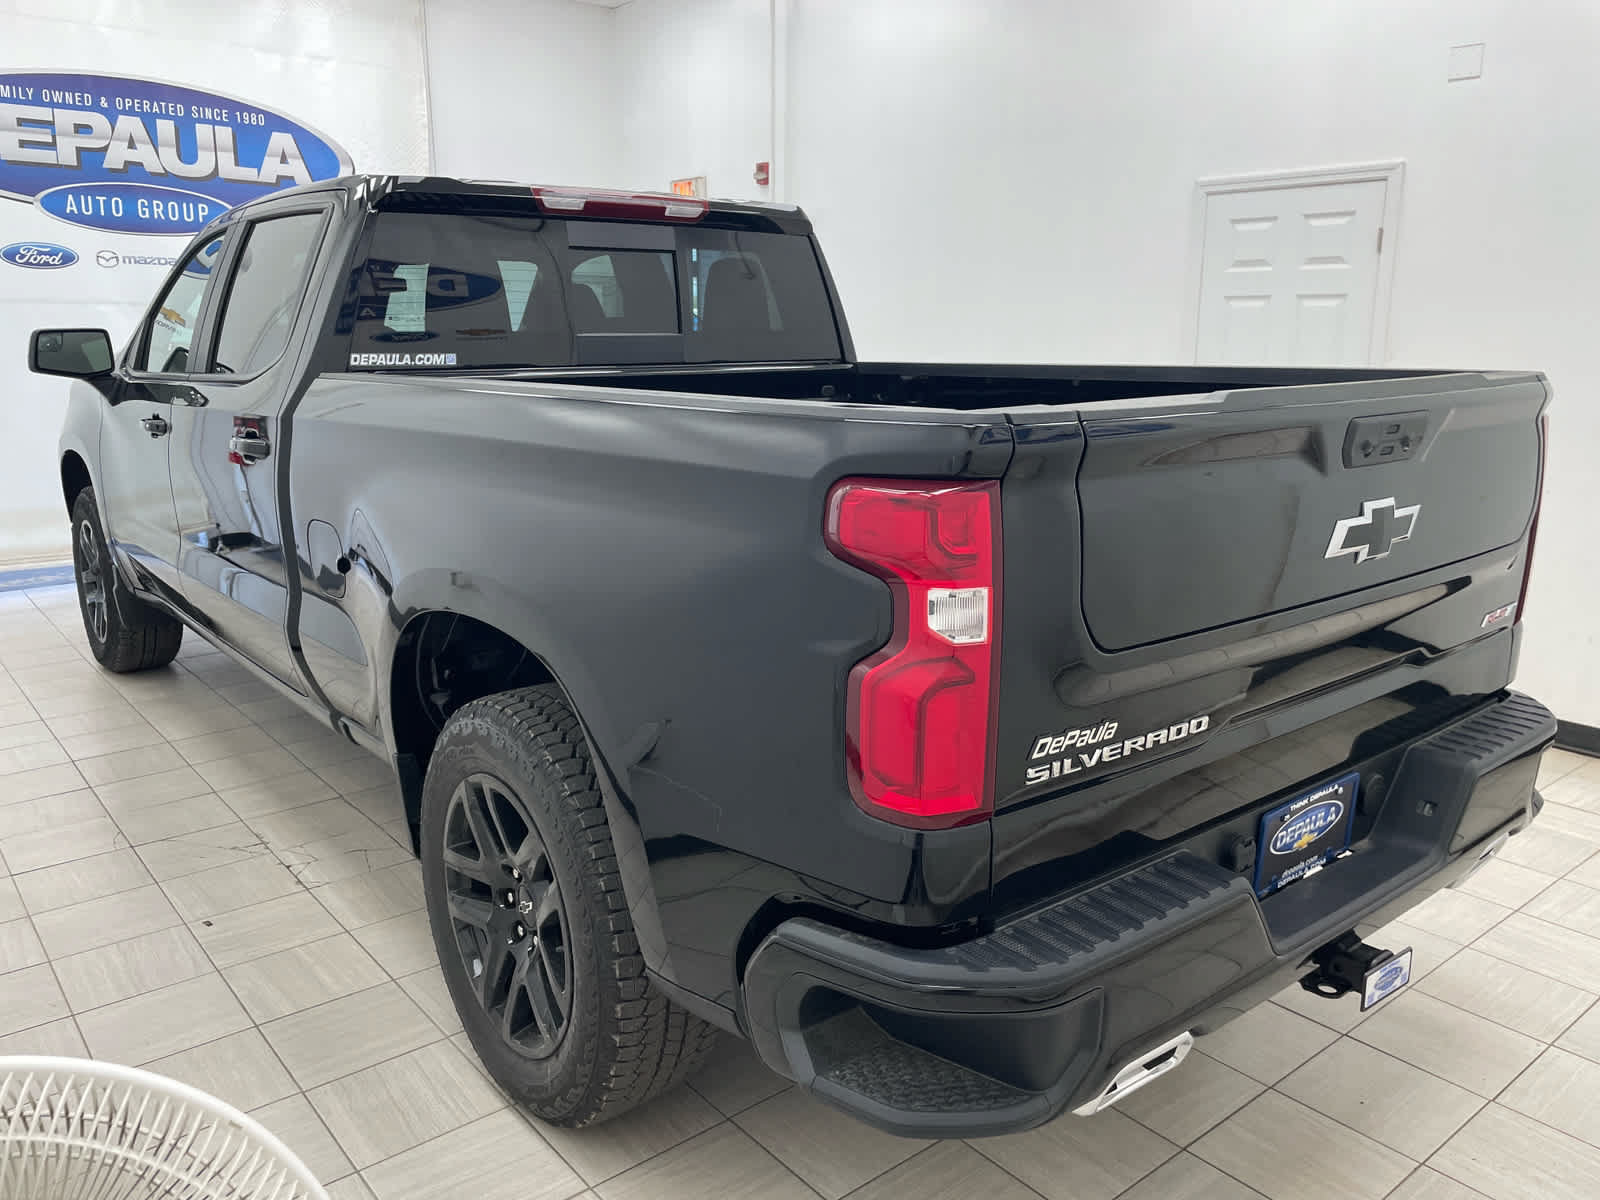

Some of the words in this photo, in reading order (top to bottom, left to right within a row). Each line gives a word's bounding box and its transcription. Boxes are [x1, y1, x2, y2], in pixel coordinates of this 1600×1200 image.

[41, 88, 92, 107] OWNED
[99, 96, 109, 108] &
[115, 97, 185, 117] OPERATED
[191, 105, 230, 122] SINCE
[235, 111, 265, 126] 1980
[0, 102, 313, 184] EPAULA
[65, 193, 124, 217] AUTO
[137, 198, 209, 223] GROUP
[15, 245, 63, 267] Ford
[350, 353, 445, 366] DEPAULA.COM
[1024, 715, 1210, 785] SILVERADO
[1276, 806, 1336, 850] DEPAULA
